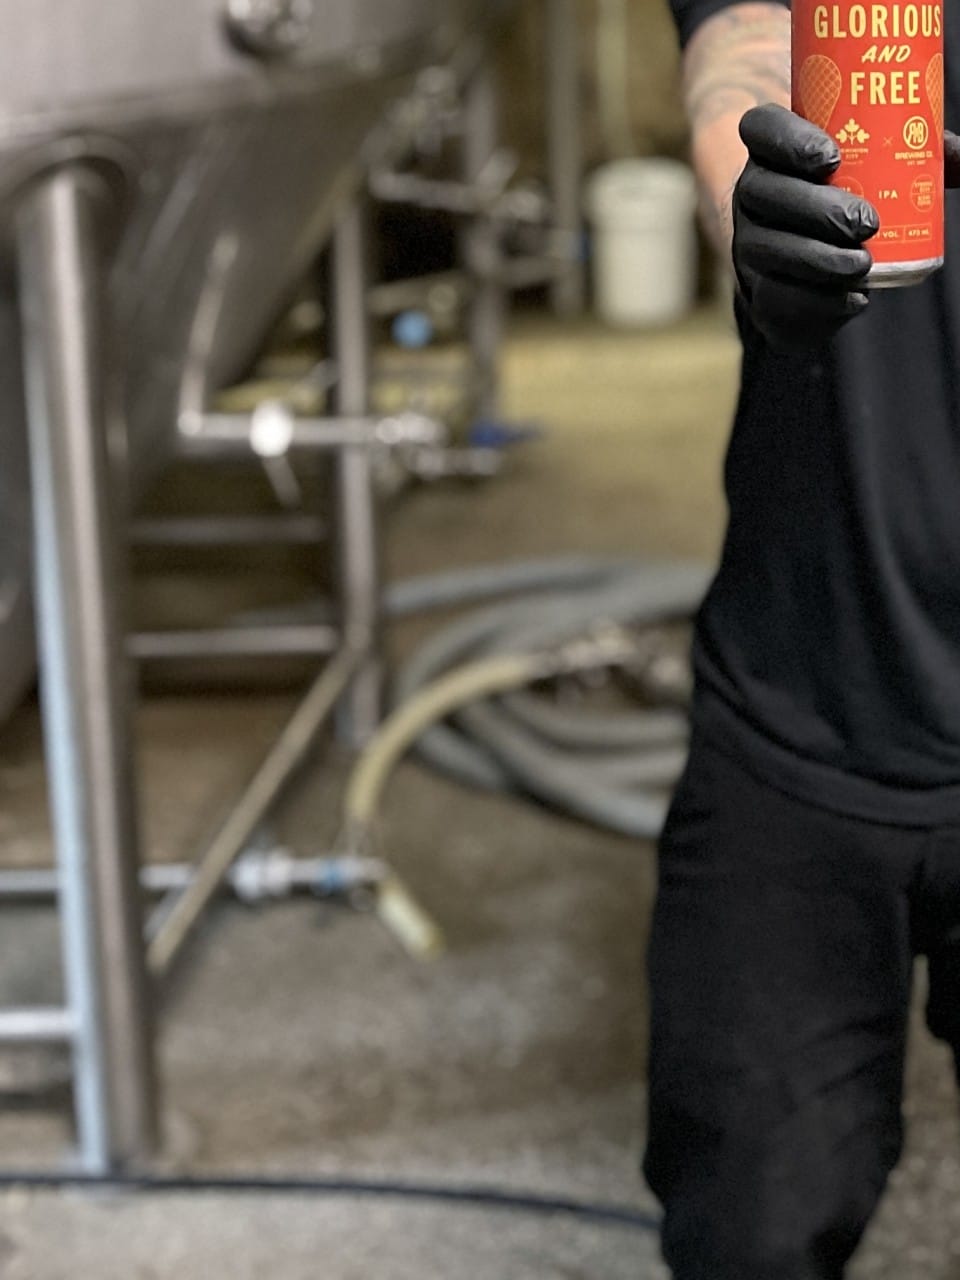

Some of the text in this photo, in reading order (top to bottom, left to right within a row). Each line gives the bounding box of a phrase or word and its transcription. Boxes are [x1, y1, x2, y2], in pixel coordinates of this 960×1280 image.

[813, 3, 941, 39] GLORIOUS
[861, 44, 911, 64] AND
[850, 71, 921, 105] FREE
[878, 190, 898, 199] IPA
